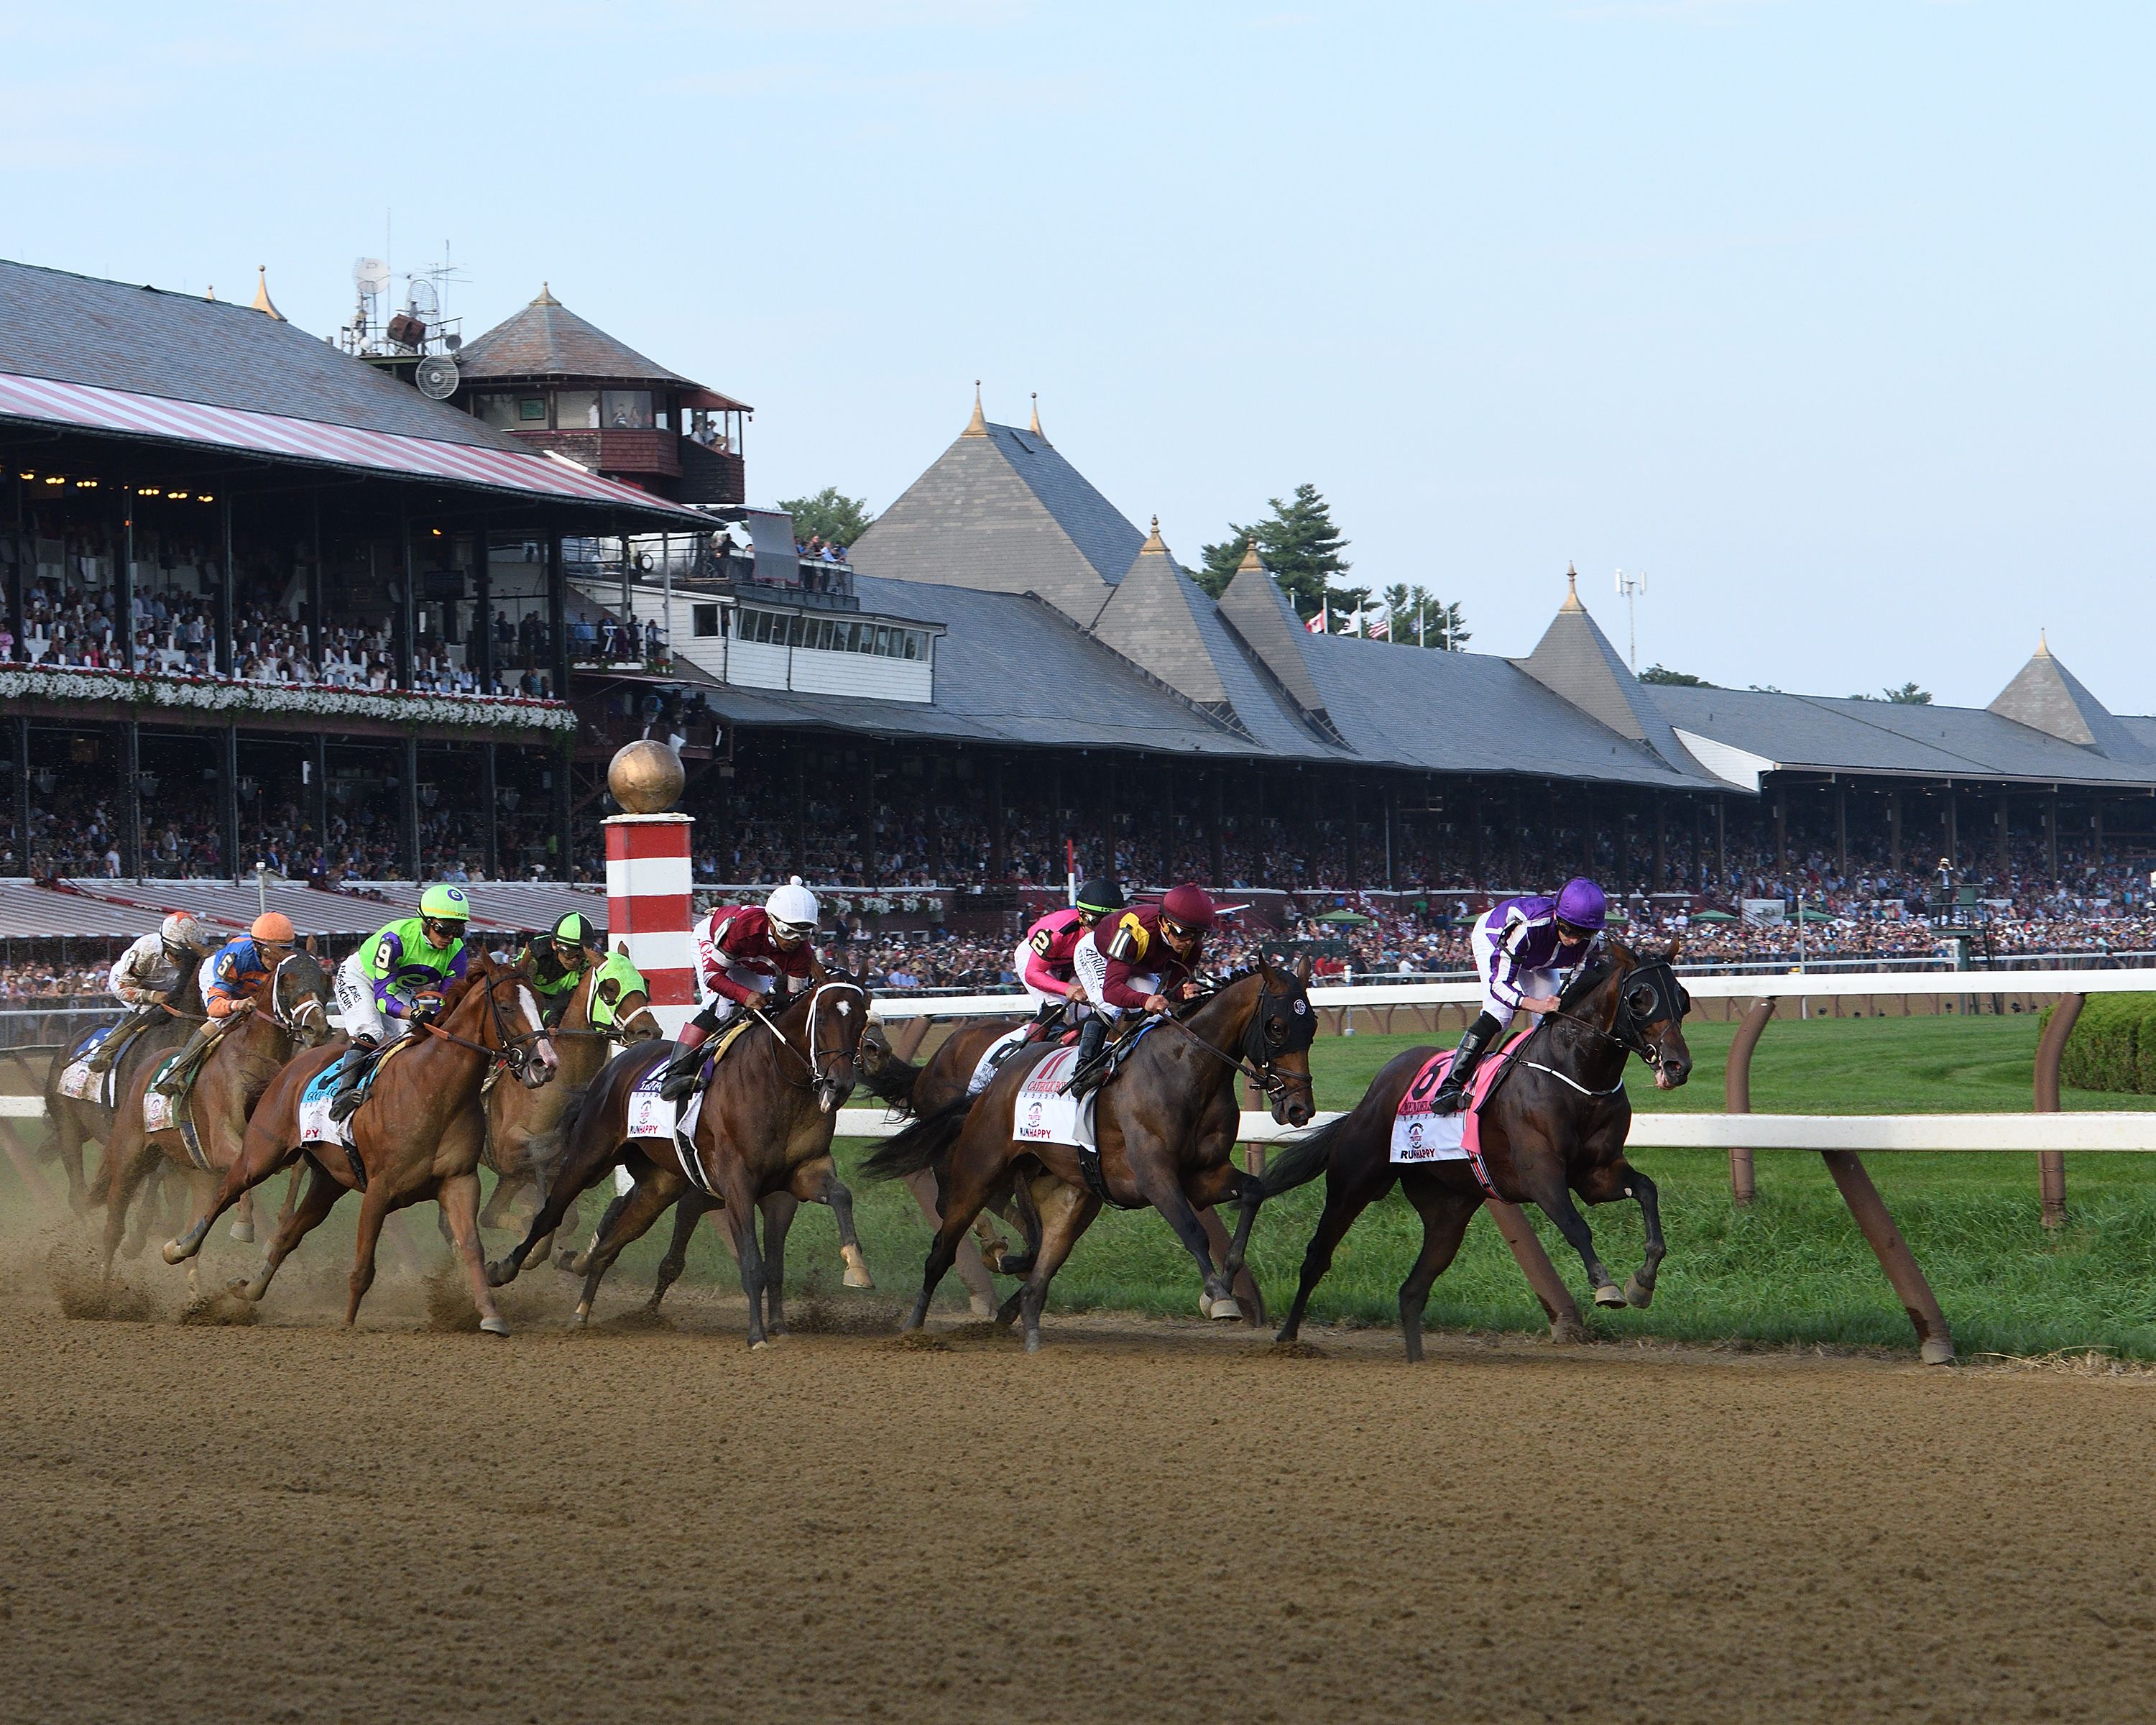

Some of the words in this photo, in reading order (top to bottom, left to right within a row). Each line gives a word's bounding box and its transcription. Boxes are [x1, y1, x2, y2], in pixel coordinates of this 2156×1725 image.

[1031, 931, 1049, 957] 2
[1108, 929, 1130, 957] 11
[217, 954, 232, 976] 5
[375, 943, 392, 968] 9
[1020, 1127, 1051, 1138] RUNHAPPY
[1400, 1148, 1436, 1159] RUNHAPPY
